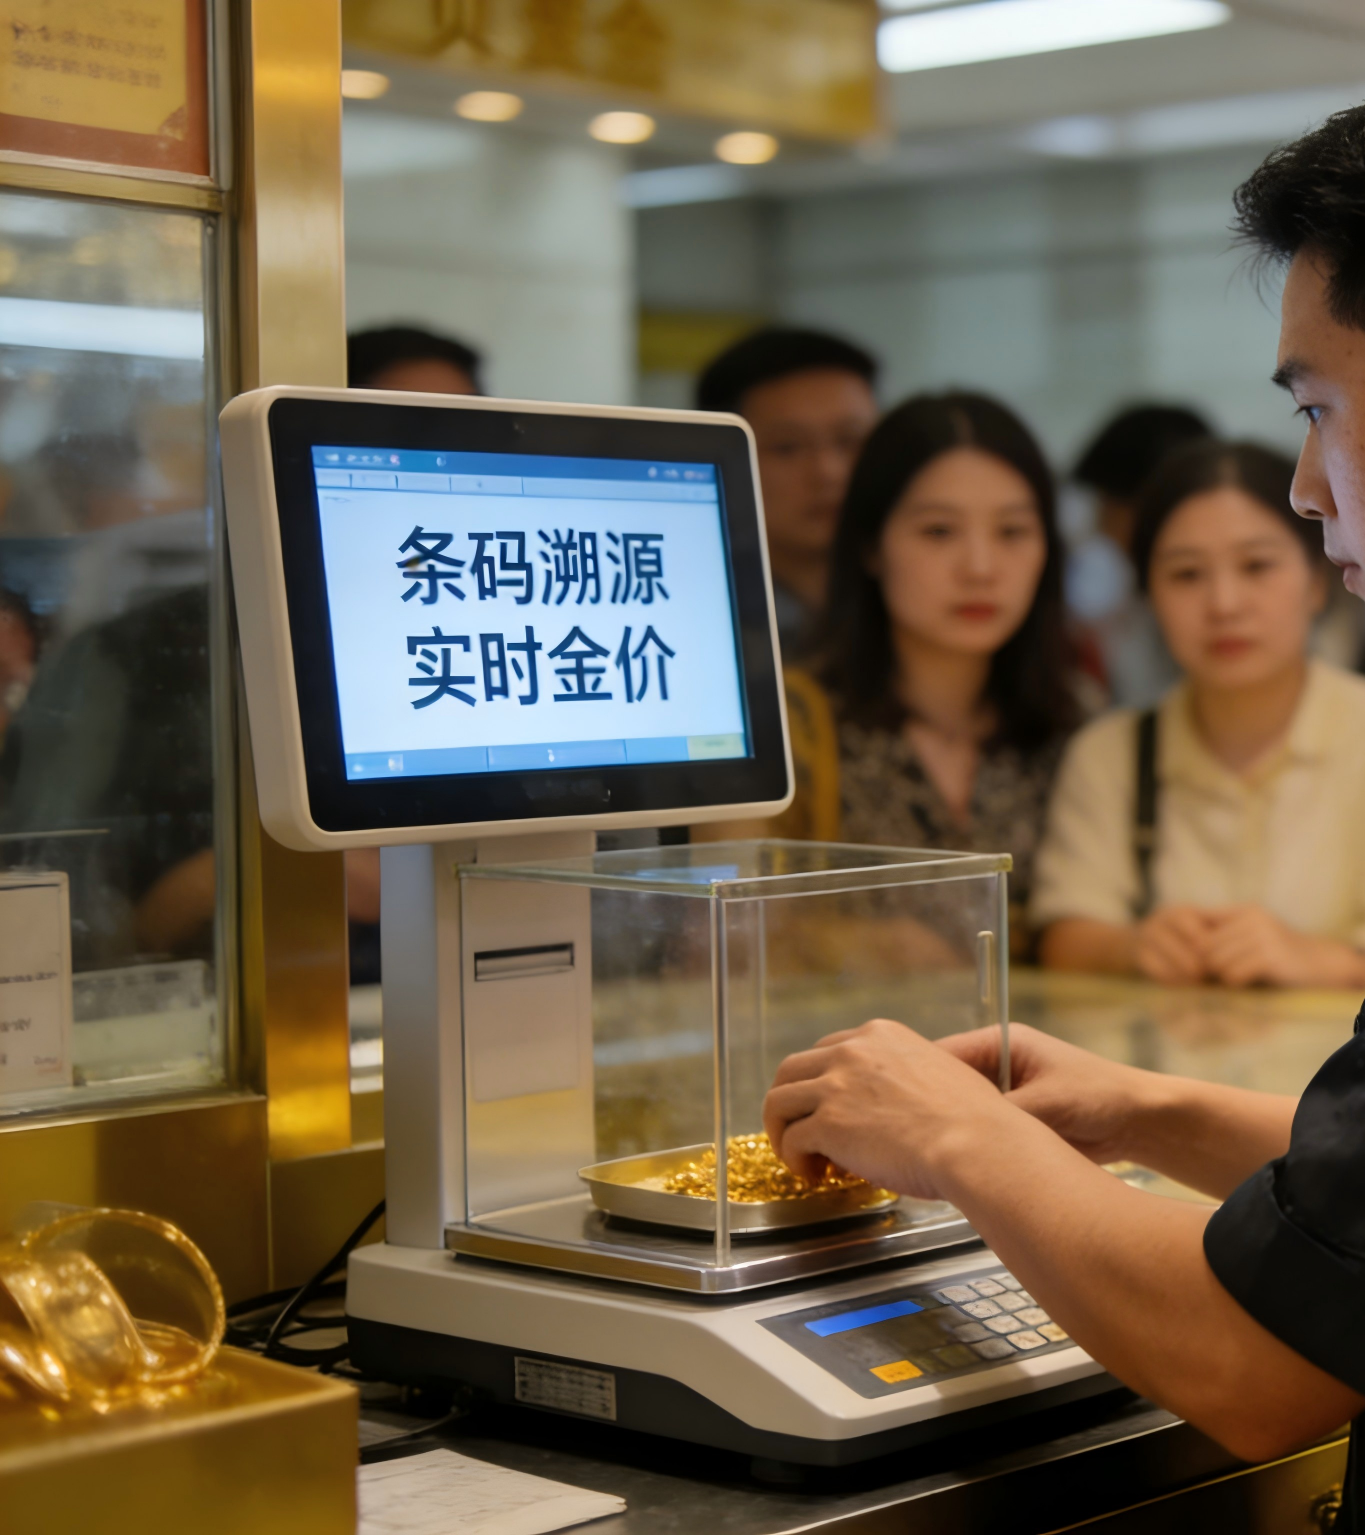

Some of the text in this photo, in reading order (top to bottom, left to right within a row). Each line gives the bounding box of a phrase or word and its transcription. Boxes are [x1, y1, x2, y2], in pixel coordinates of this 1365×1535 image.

[396, 525, 671, 606] 条码溯源
[406, 624, 676, 711] 实时金价
